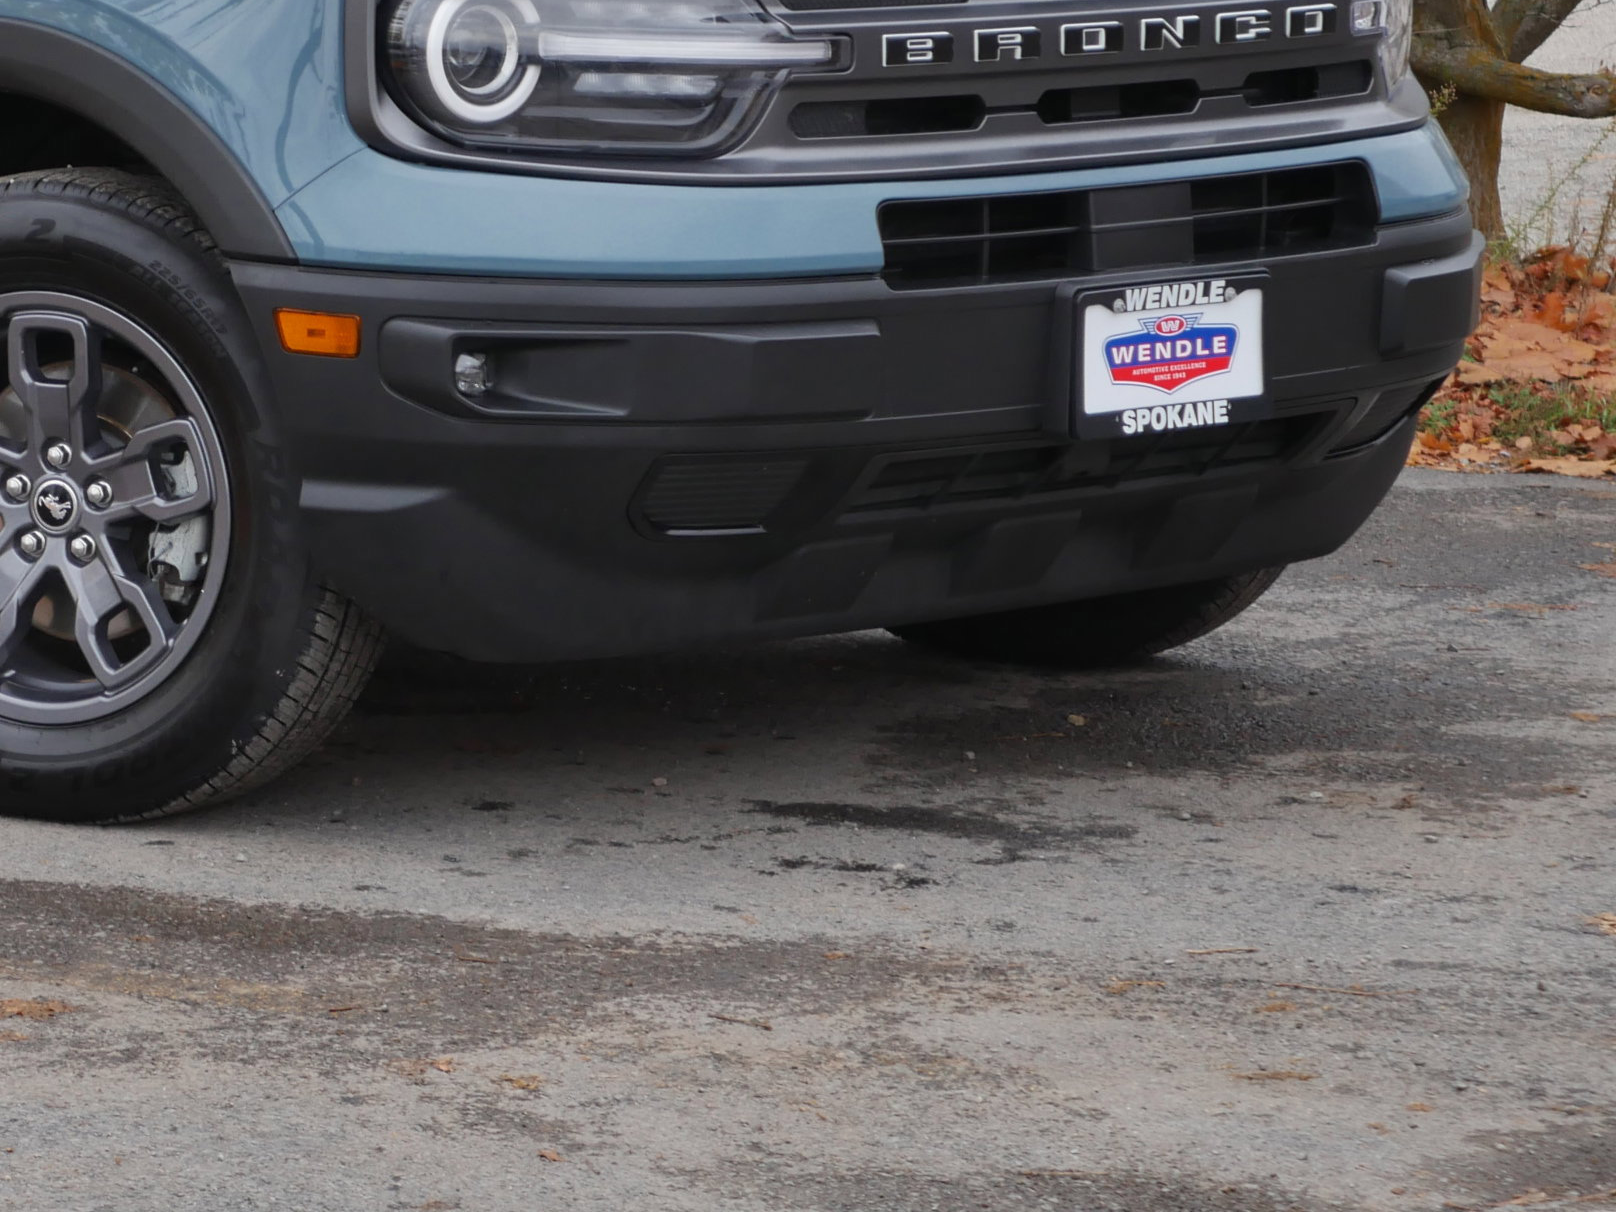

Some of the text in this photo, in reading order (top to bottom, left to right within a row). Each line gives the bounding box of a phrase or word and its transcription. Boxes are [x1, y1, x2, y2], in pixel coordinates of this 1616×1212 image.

[882, 2, 1338, 68] BRONCO
[1124, 279, 1227, 312] WENDLE
[1111, 335, 1228, 365] WENDLE
[1132, 361, 1207, 376] AUTOMOTIVE EXCELLENCE
[1153, 373, 1172, 382] SINCE
[1122, 399, 1230, 435] SPOKANE
